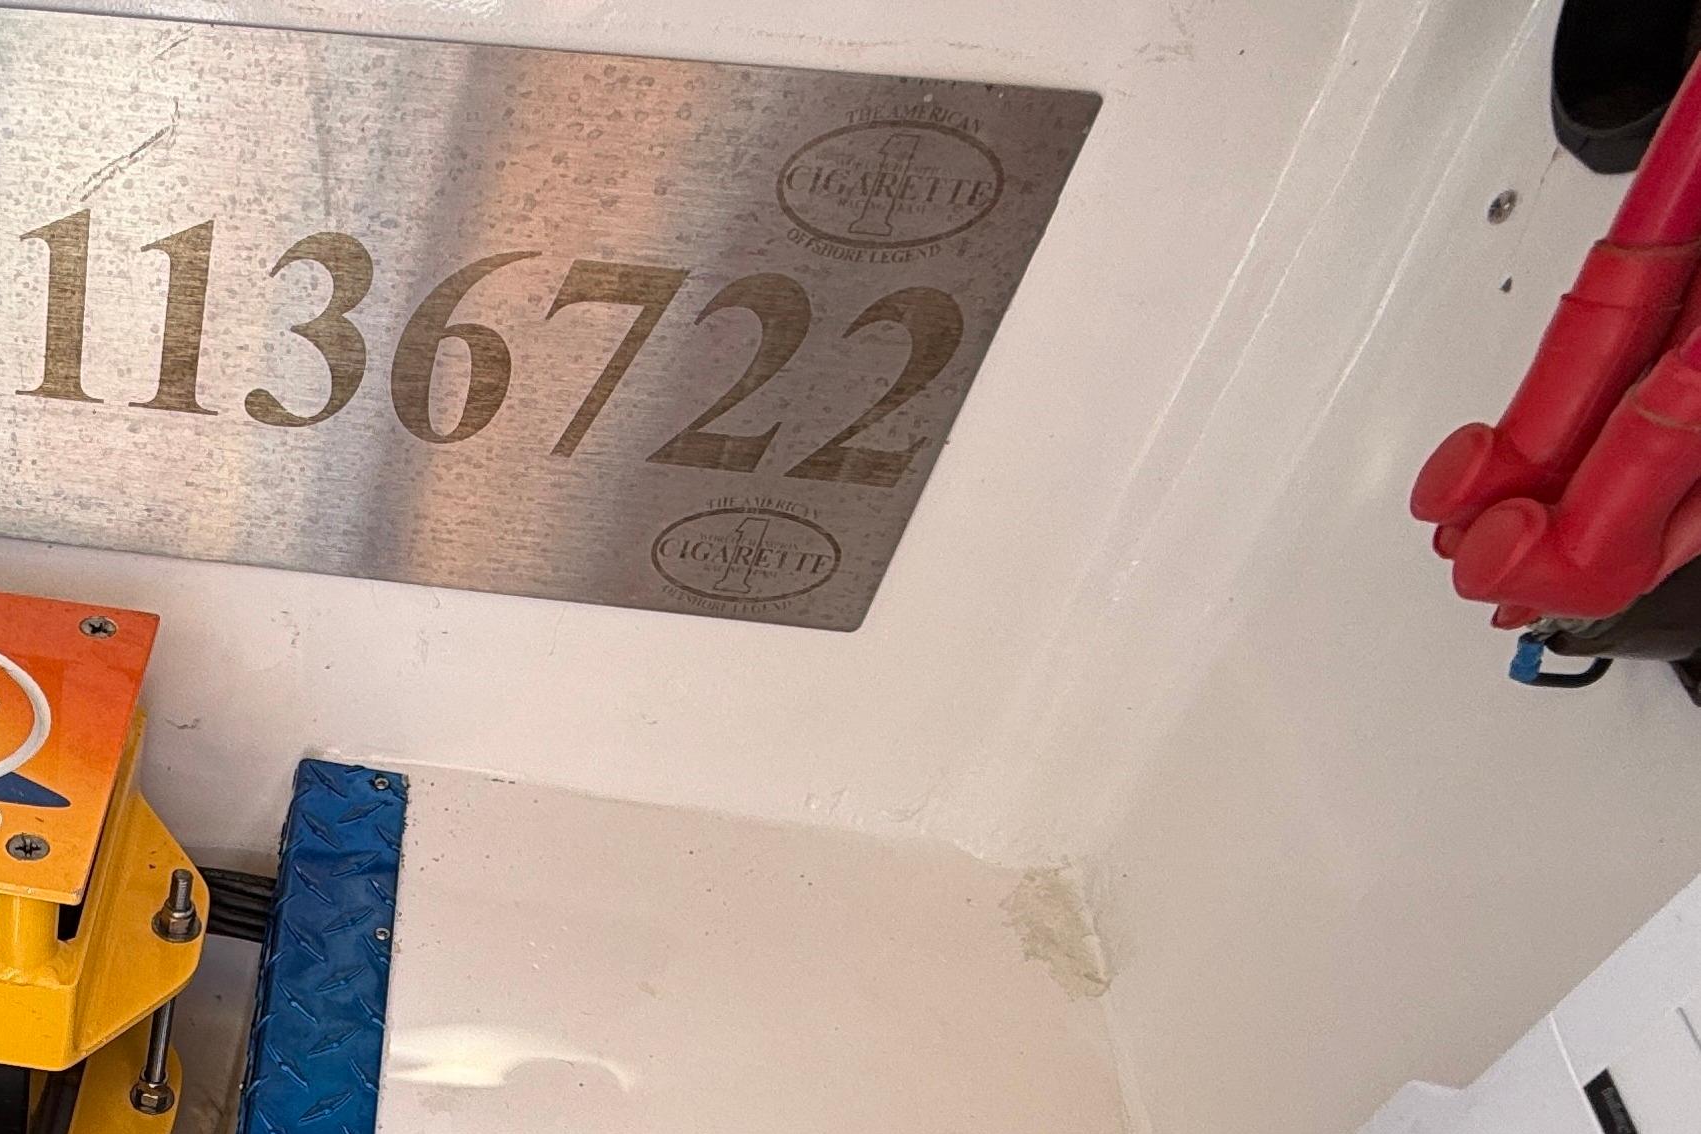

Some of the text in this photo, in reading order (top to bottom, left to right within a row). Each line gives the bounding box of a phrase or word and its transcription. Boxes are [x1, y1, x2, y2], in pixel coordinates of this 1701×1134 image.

[845, 104, 986, 134] THE AMERICAN
[785, 164, 993, 207] CIGARETTE
[786, 227, 942, 264] OFFSHORE LEGEND
[14, 207, 965, 488] 1136722
[658, 536, 834, 575] CIGARETTE
